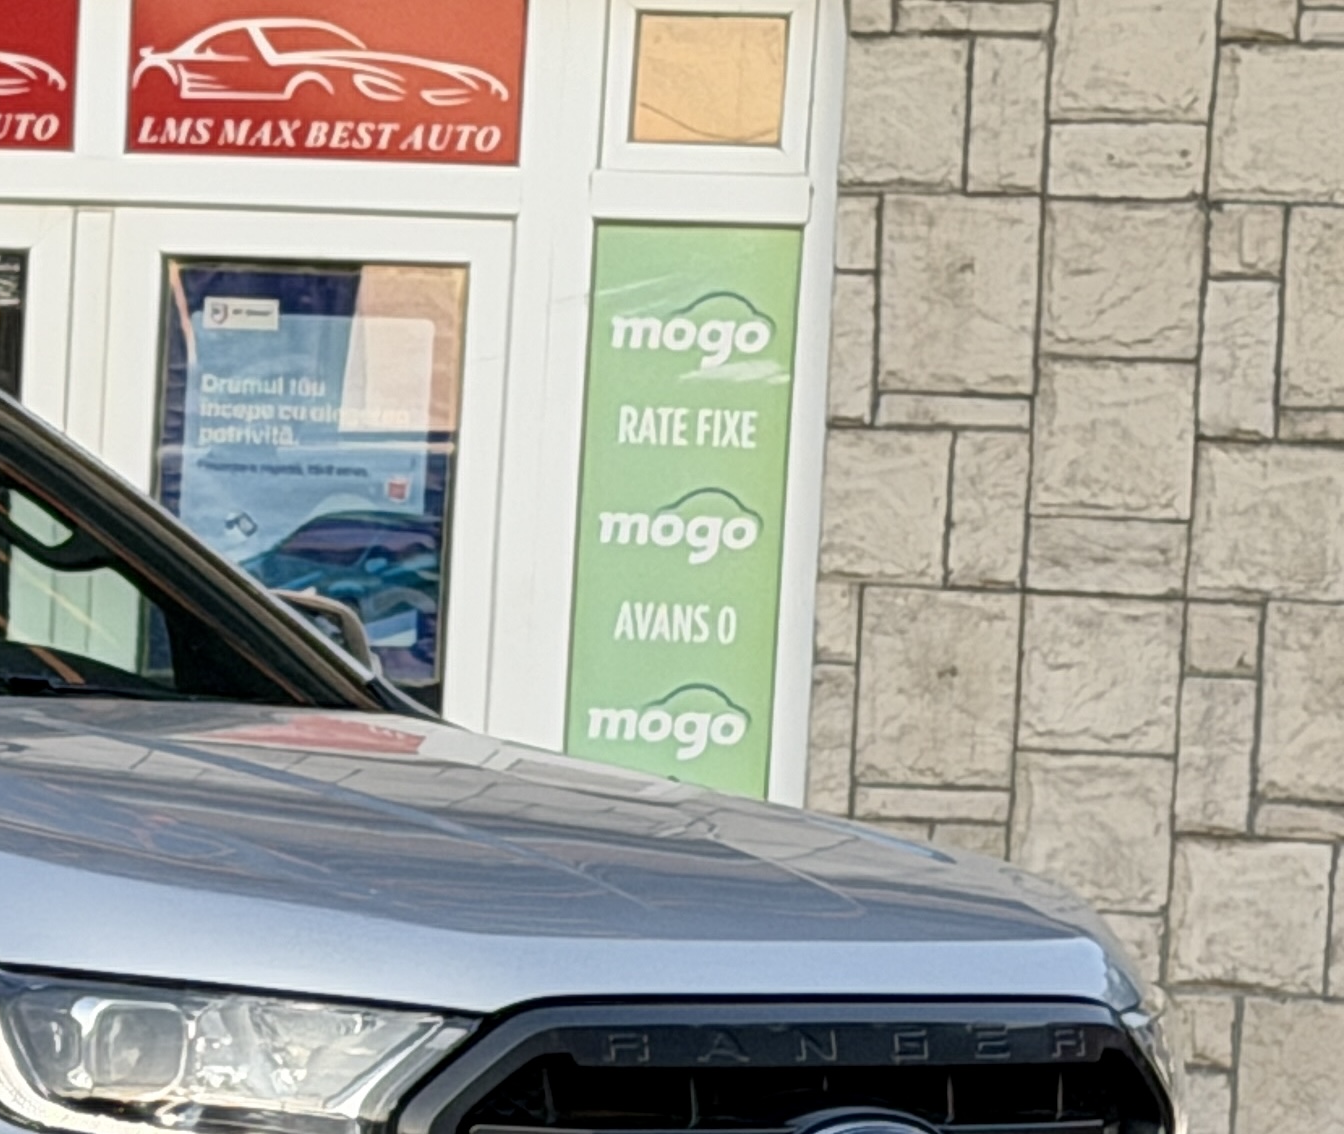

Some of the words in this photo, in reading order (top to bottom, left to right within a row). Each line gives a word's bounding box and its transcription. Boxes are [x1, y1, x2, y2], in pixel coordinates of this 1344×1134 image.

[137, 116, 214, 145] LMS
[217, 119, 302, 147] MAX
[304, 121, 400, 150] BEST
[399, 124, 502, 152] AUTO
[611, 315, 771, 369] mogo
[200, 373, 283, 397] Drumul
[618, 405, 690, 447] RATE
[696, 408, 759, 449] FIXE
[599, 511, 759, 565] mogo
[613, 600, 710, 644] AVANS
[587, 707, 747, 761] mogo
[606, 1024, 1085, 1065] RANGER
